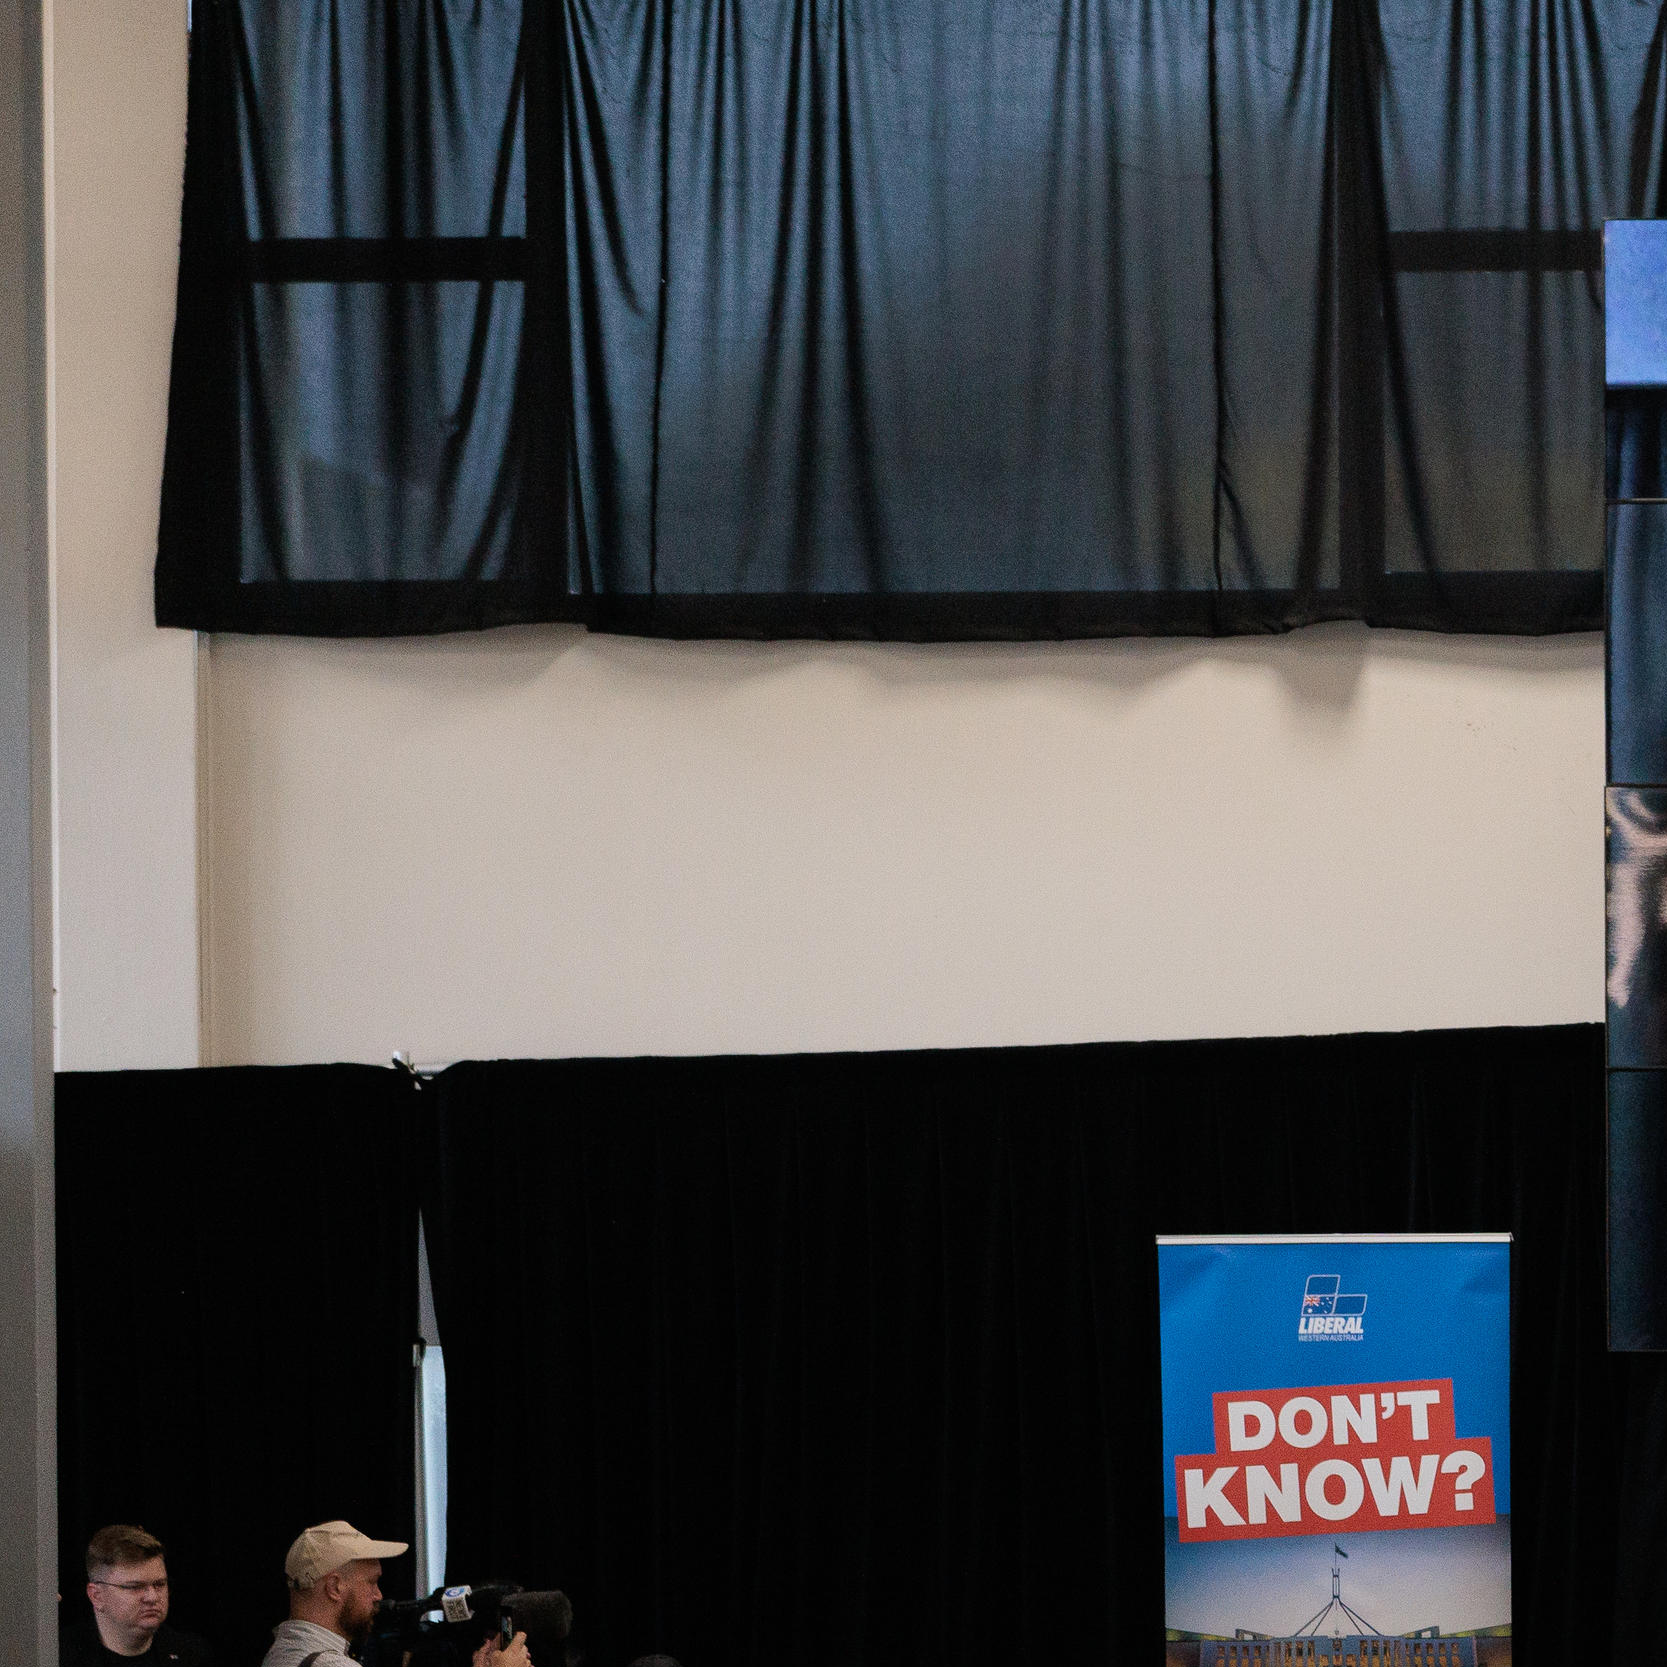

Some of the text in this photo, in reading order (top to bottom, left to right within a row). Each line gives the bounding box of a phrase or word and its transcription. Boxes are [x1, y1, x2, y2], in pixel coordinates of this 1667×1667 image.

[1298, 1316, 1364, 1335] LIBERAL
[1329, 1334, 1364, 1342] AUSTRALIA
[1227, 1389, 1441, 1452] DON'T
[1184, 1450, 1486, 1529] KNOW?
